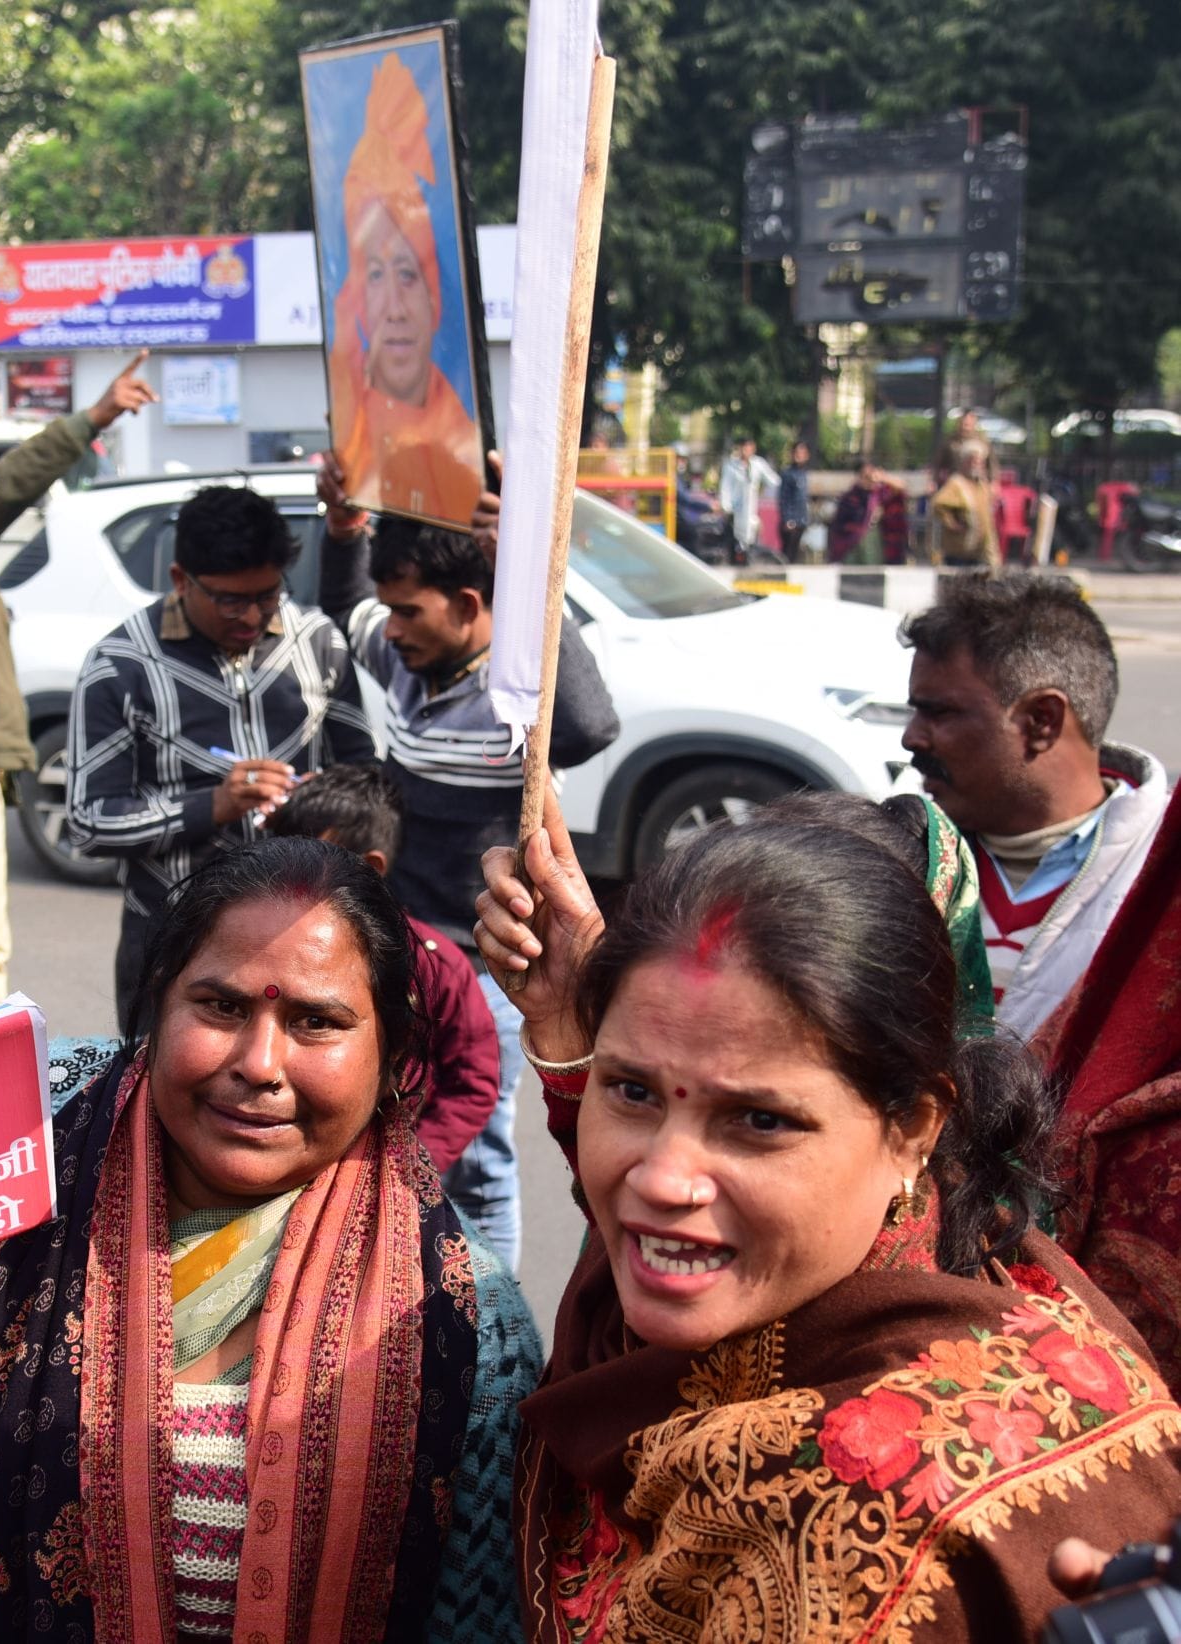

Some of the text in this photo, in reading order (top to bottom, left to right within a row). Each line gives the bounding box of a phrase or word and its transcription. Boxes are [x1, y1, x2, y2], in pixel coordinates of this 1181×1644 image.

[22, 243, 202, 304] यातायात पुलिस चौकी
